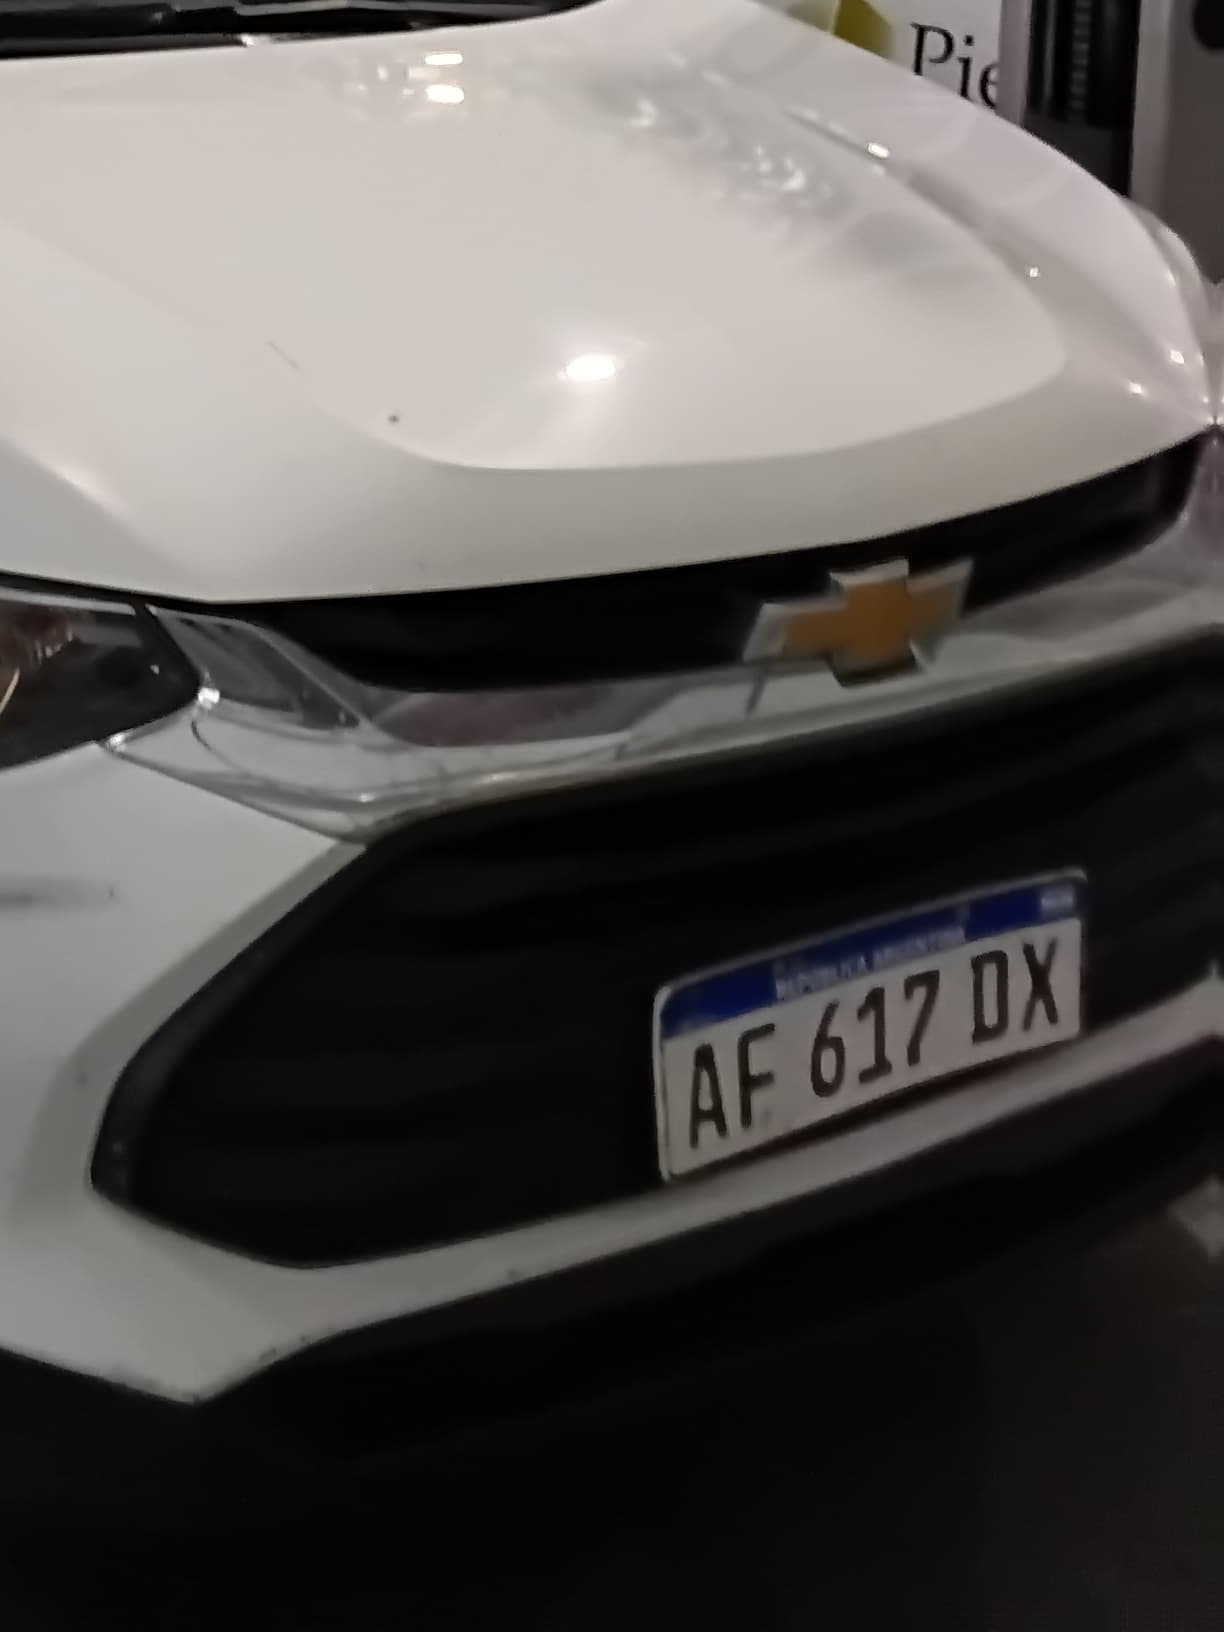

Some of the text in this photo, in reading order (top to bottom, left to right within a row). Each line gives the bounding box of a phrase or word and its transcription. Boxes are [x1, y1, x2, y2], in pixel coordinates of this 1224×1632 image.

[689, 938, 1059, 1149] AF 617 DX
